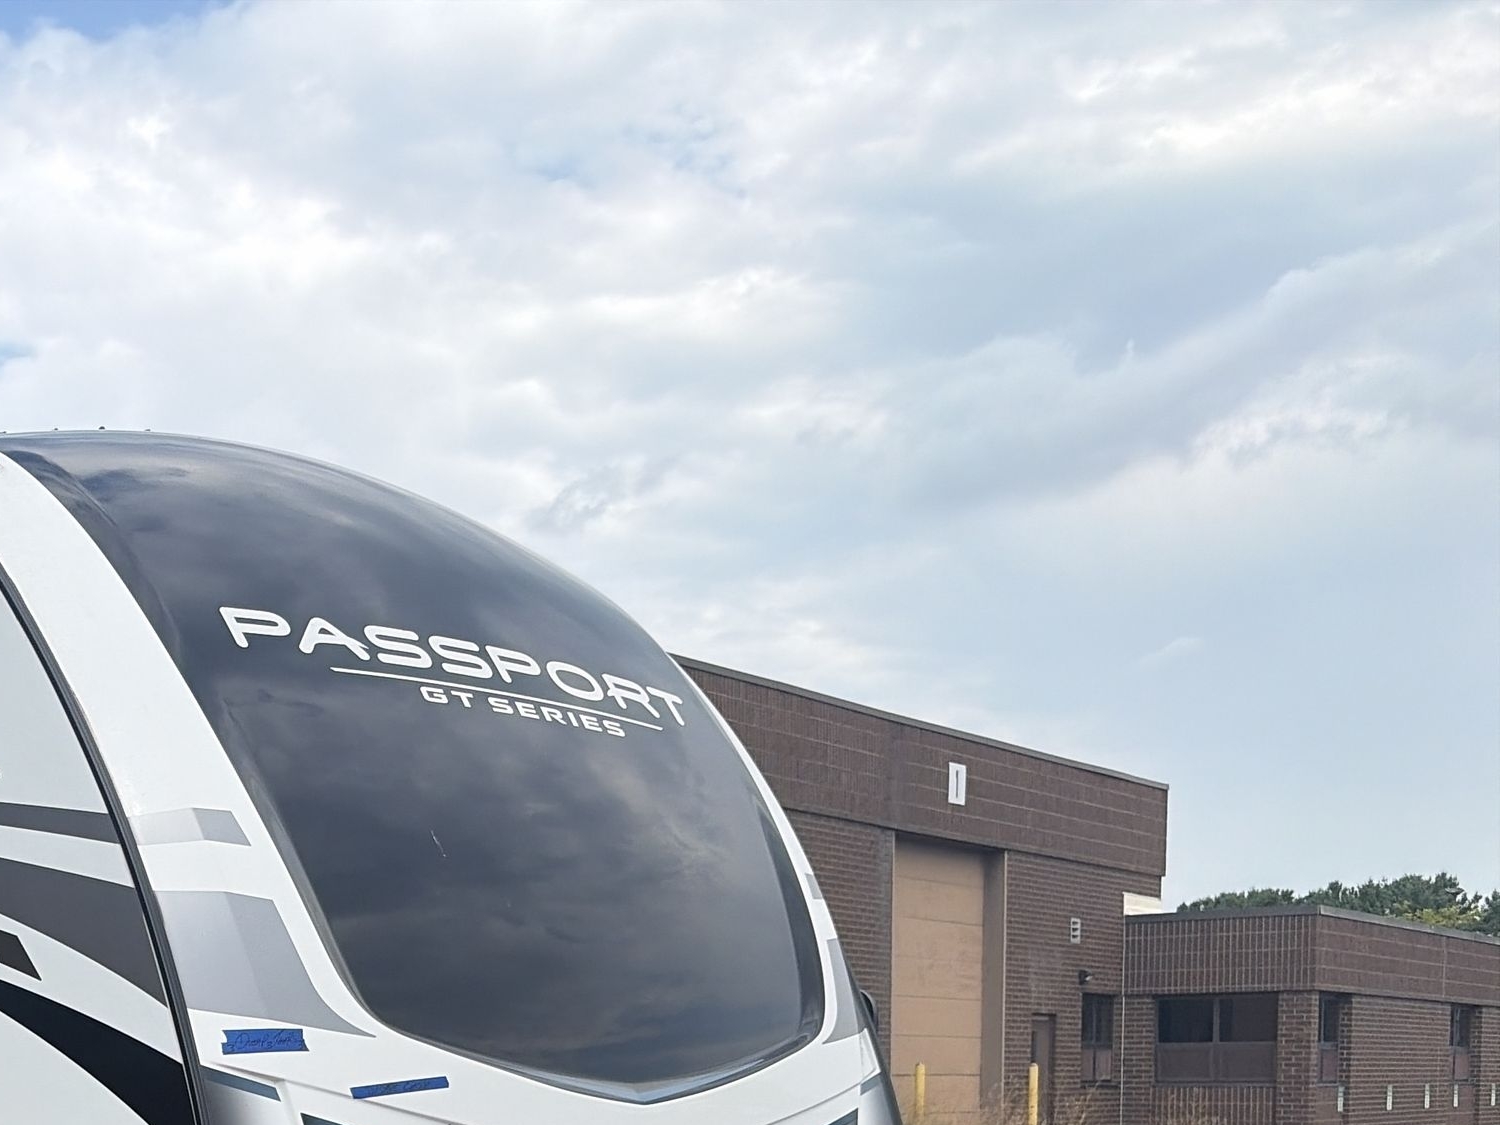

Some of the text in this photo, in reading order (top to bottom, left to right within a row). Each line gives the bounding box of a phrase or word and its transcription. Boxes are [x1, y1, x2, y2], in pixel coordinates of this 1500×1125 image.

[218, 606, 685, 726] PASSPORT
[419, 685, 626, 737] GT SERIES
